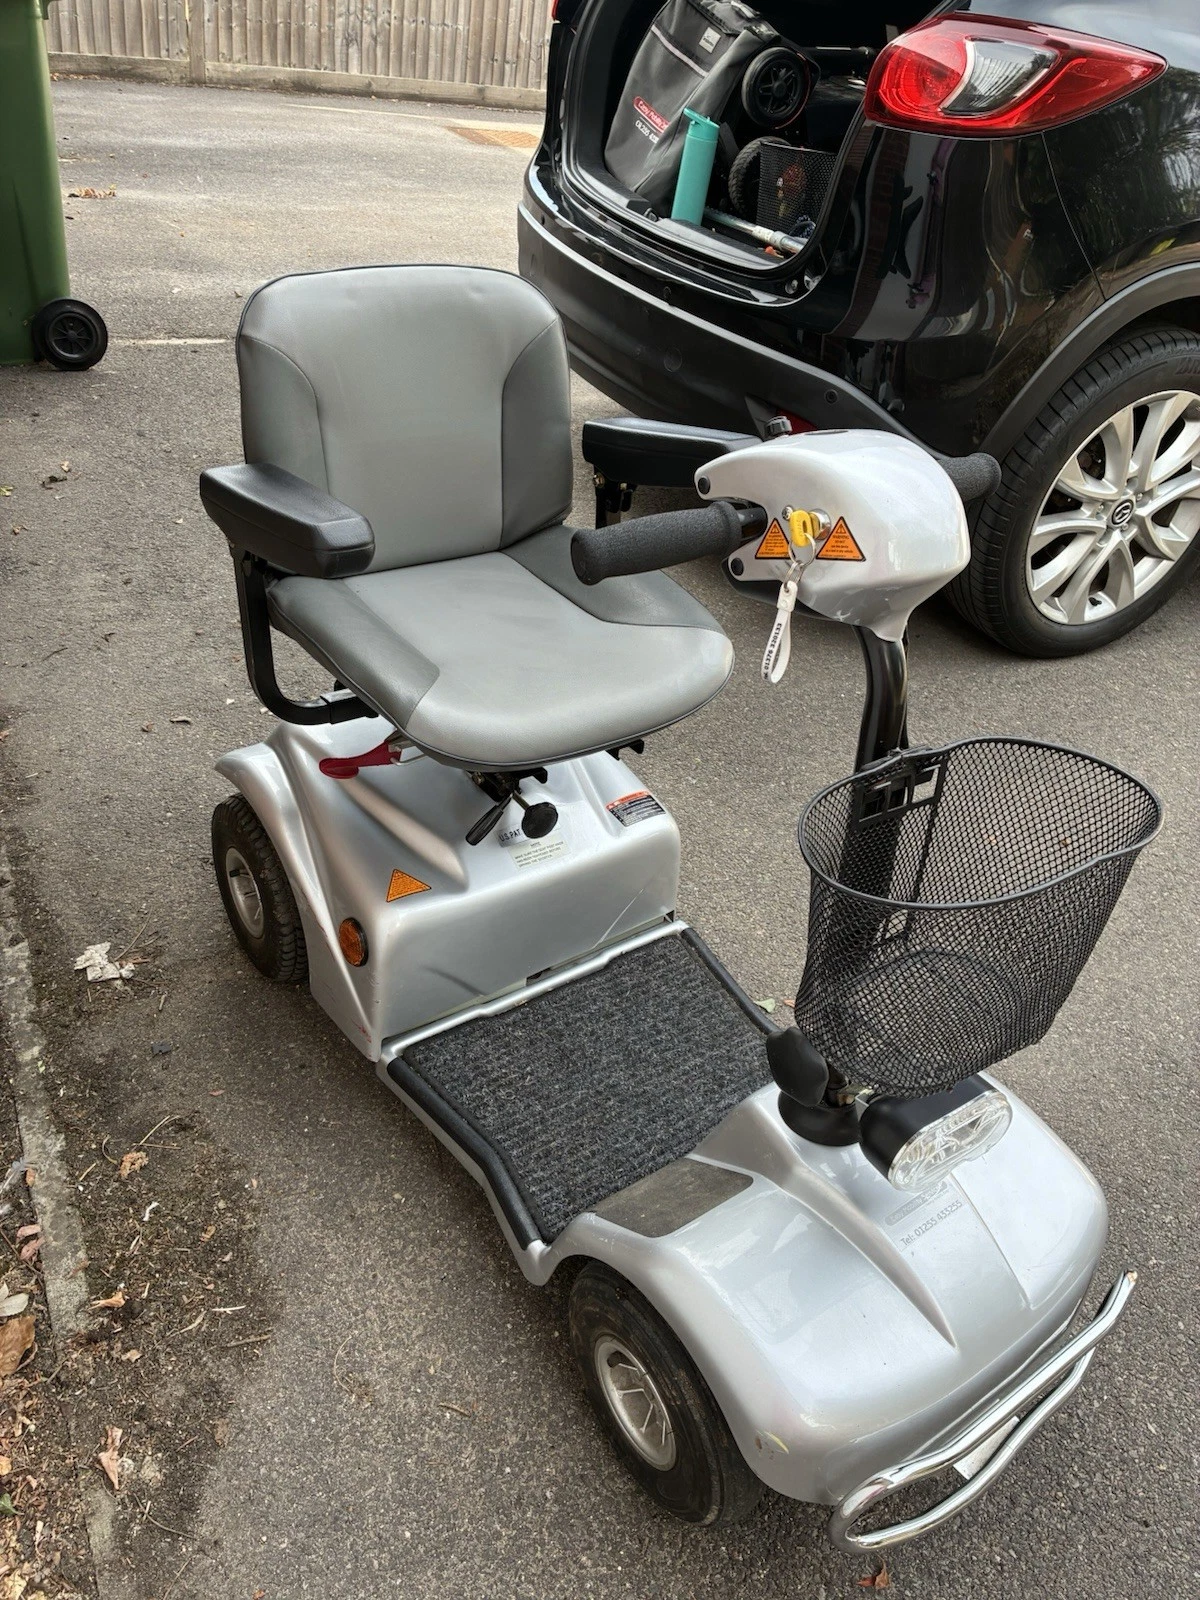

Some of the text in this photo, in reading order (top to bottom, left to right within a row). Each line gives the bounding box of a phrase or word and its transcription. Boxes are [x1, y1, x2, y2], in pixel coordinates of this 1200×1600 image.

[764, 649, 774, 671] 01376
[769, 623, 782, 648] 320133
[900, 1199, 963, 1246] Tel: 01255 433255
